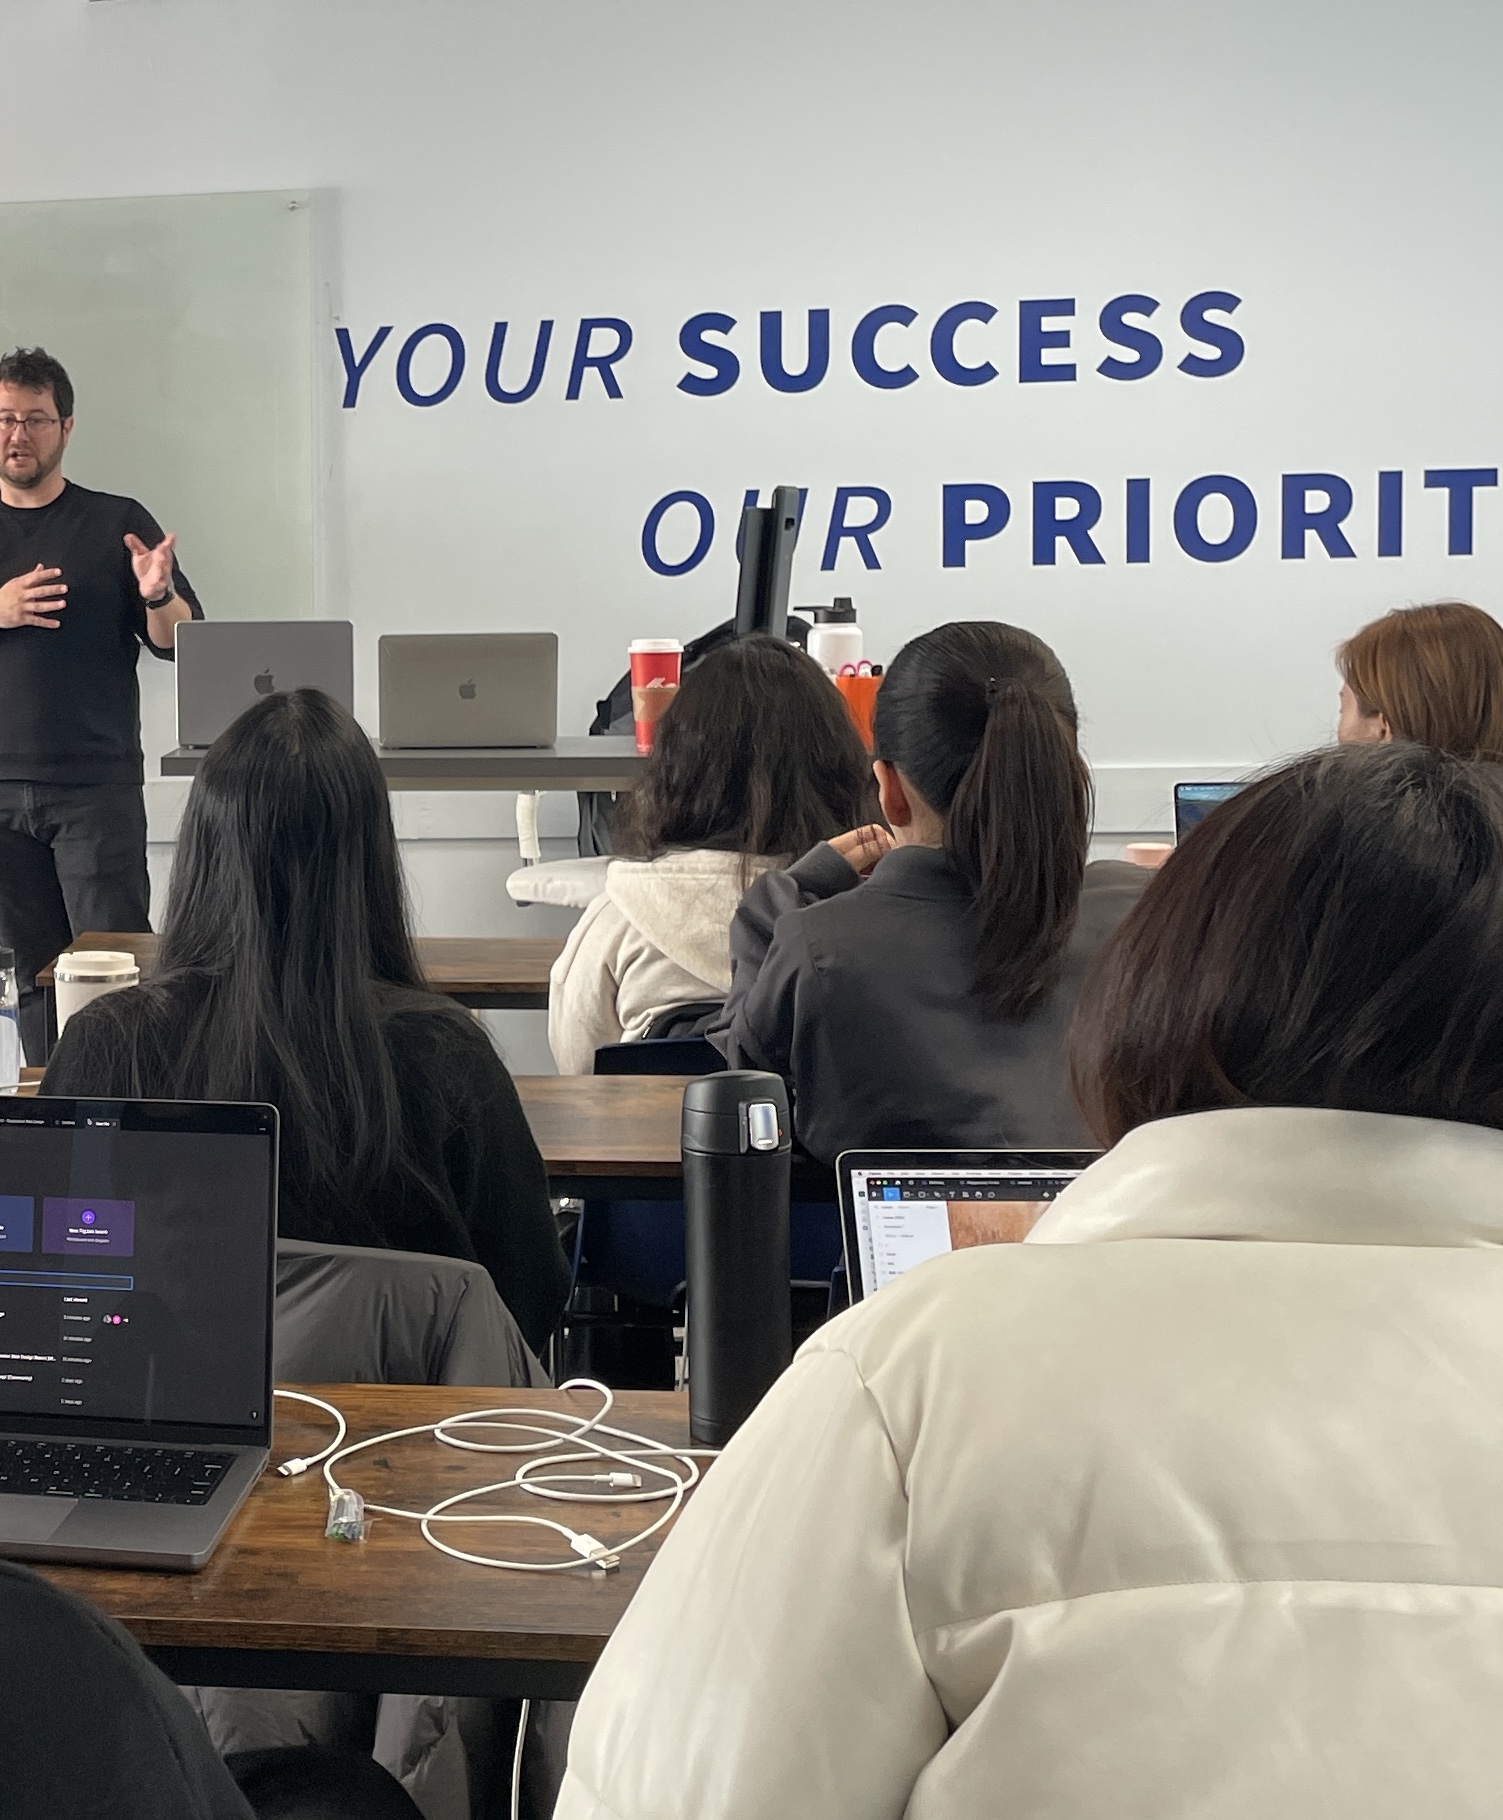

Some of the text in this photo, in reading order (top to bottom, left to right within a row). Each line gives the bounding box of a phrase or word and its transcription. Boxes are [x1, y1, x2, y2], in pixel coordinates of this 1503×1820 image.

[335, 291, 1245, 409] YOUR SUCCESS
[942, 468, 1498, 568] PRIORIT
